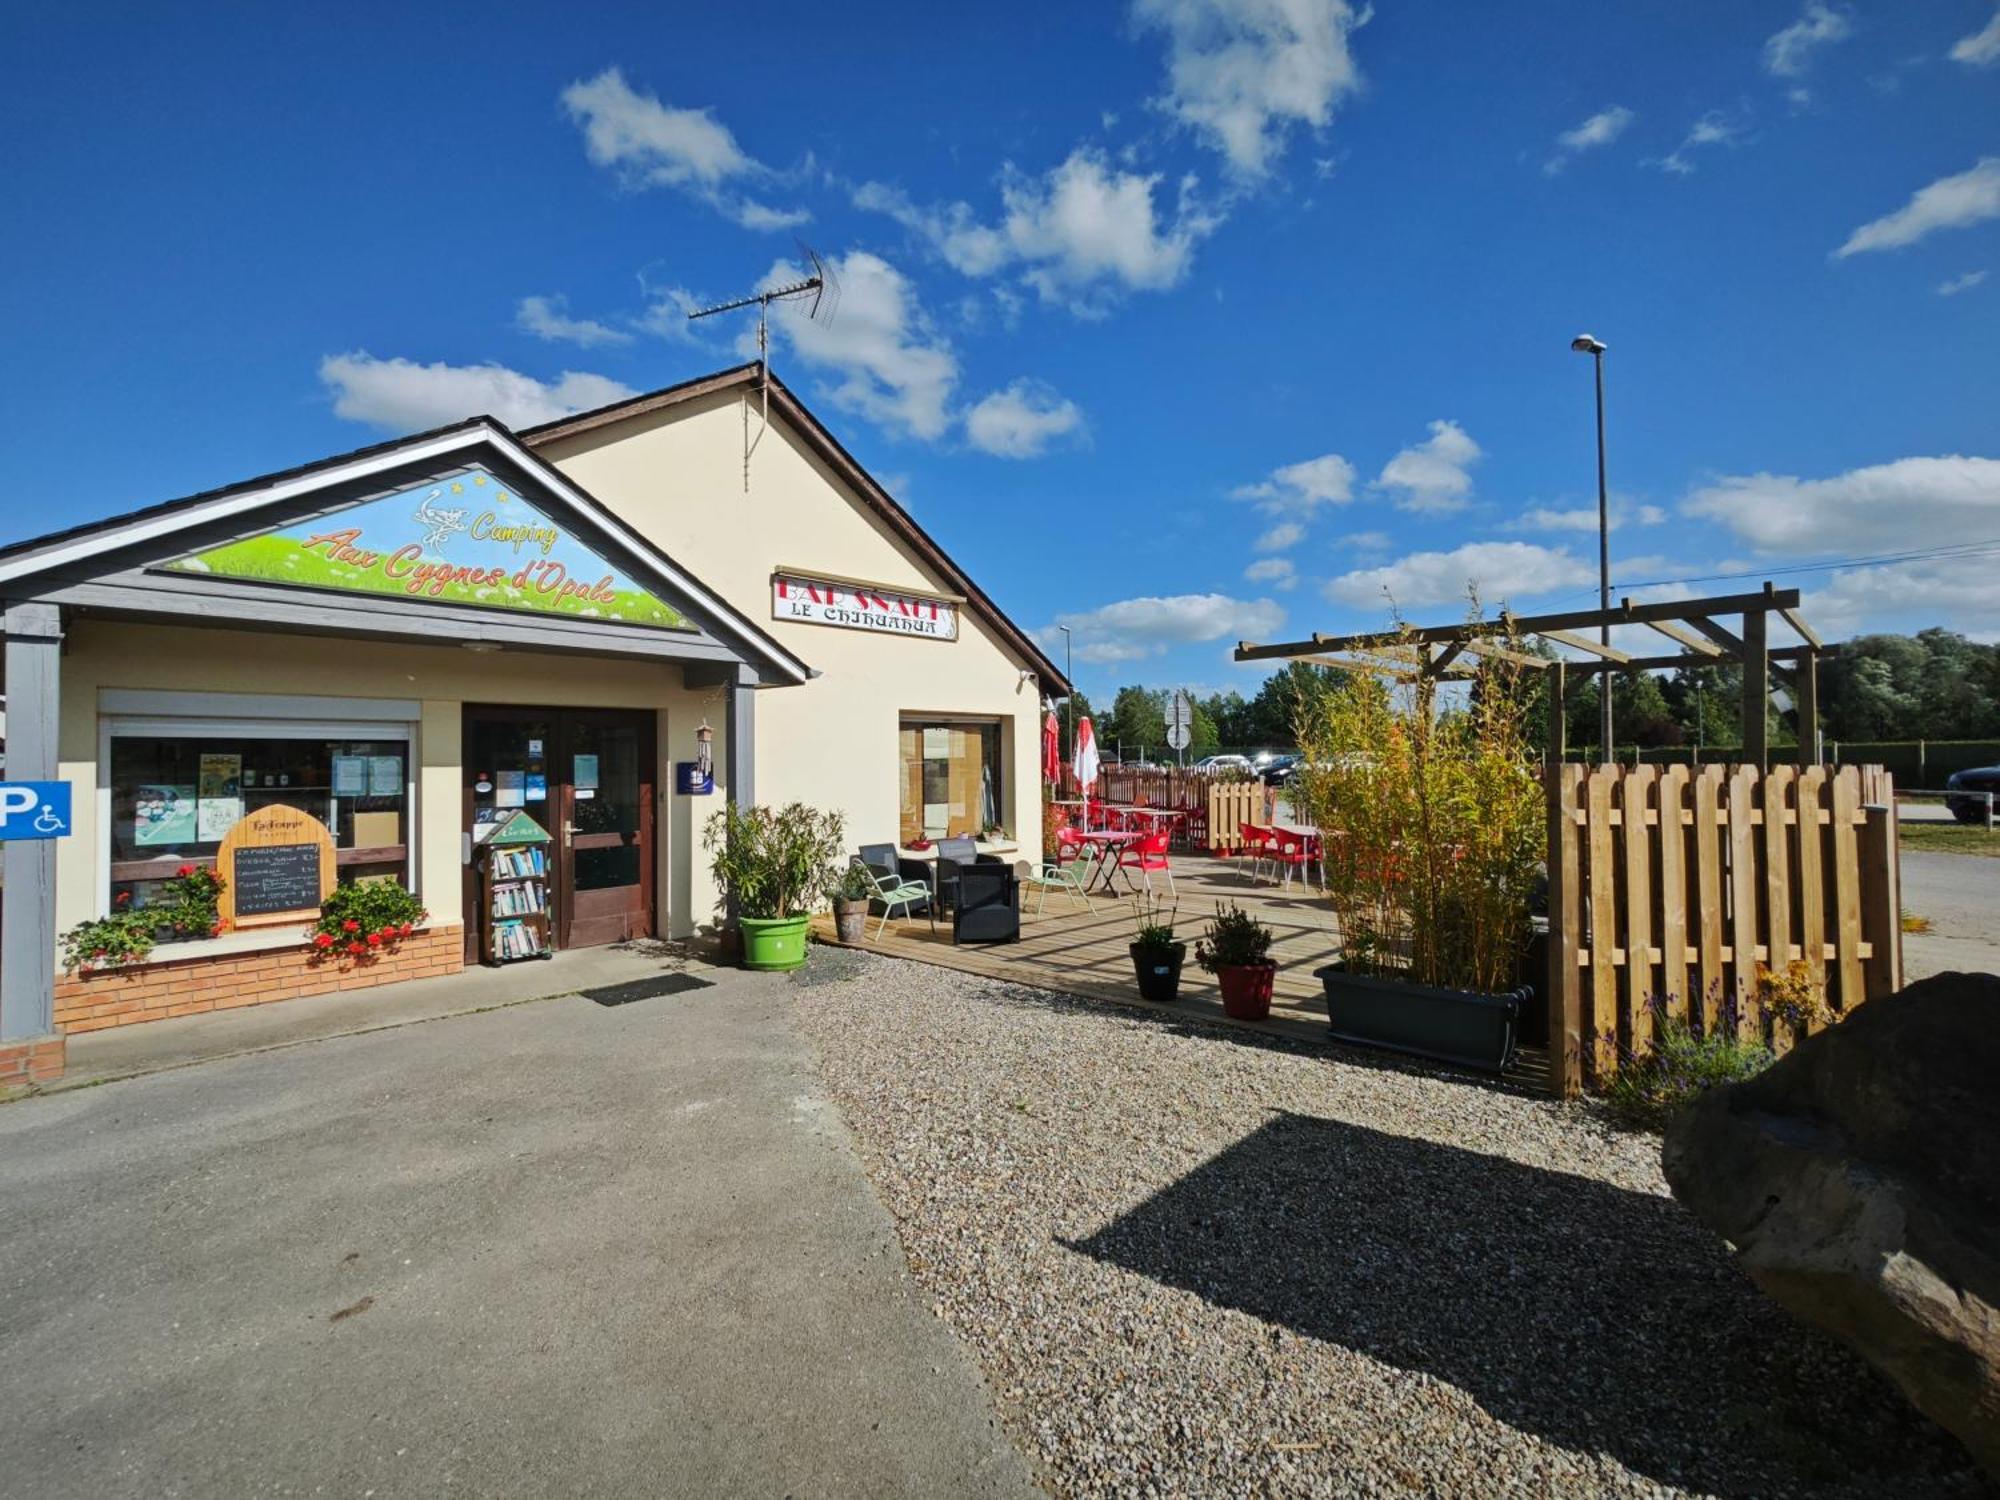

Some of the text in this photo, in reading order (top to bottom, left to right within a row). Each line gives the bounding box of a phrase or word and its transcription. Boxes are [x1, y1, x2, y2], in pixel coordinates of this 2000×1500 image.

[471, 512, 558, 554] Camping
[301, 528, 618, 605] Aux Cygnes d'Opale
[776, 578, 946, 622] BAR SNACK
[791, 602, 937, 634] LE CHIHUAHUA
[0, 786, 39, 827] P
